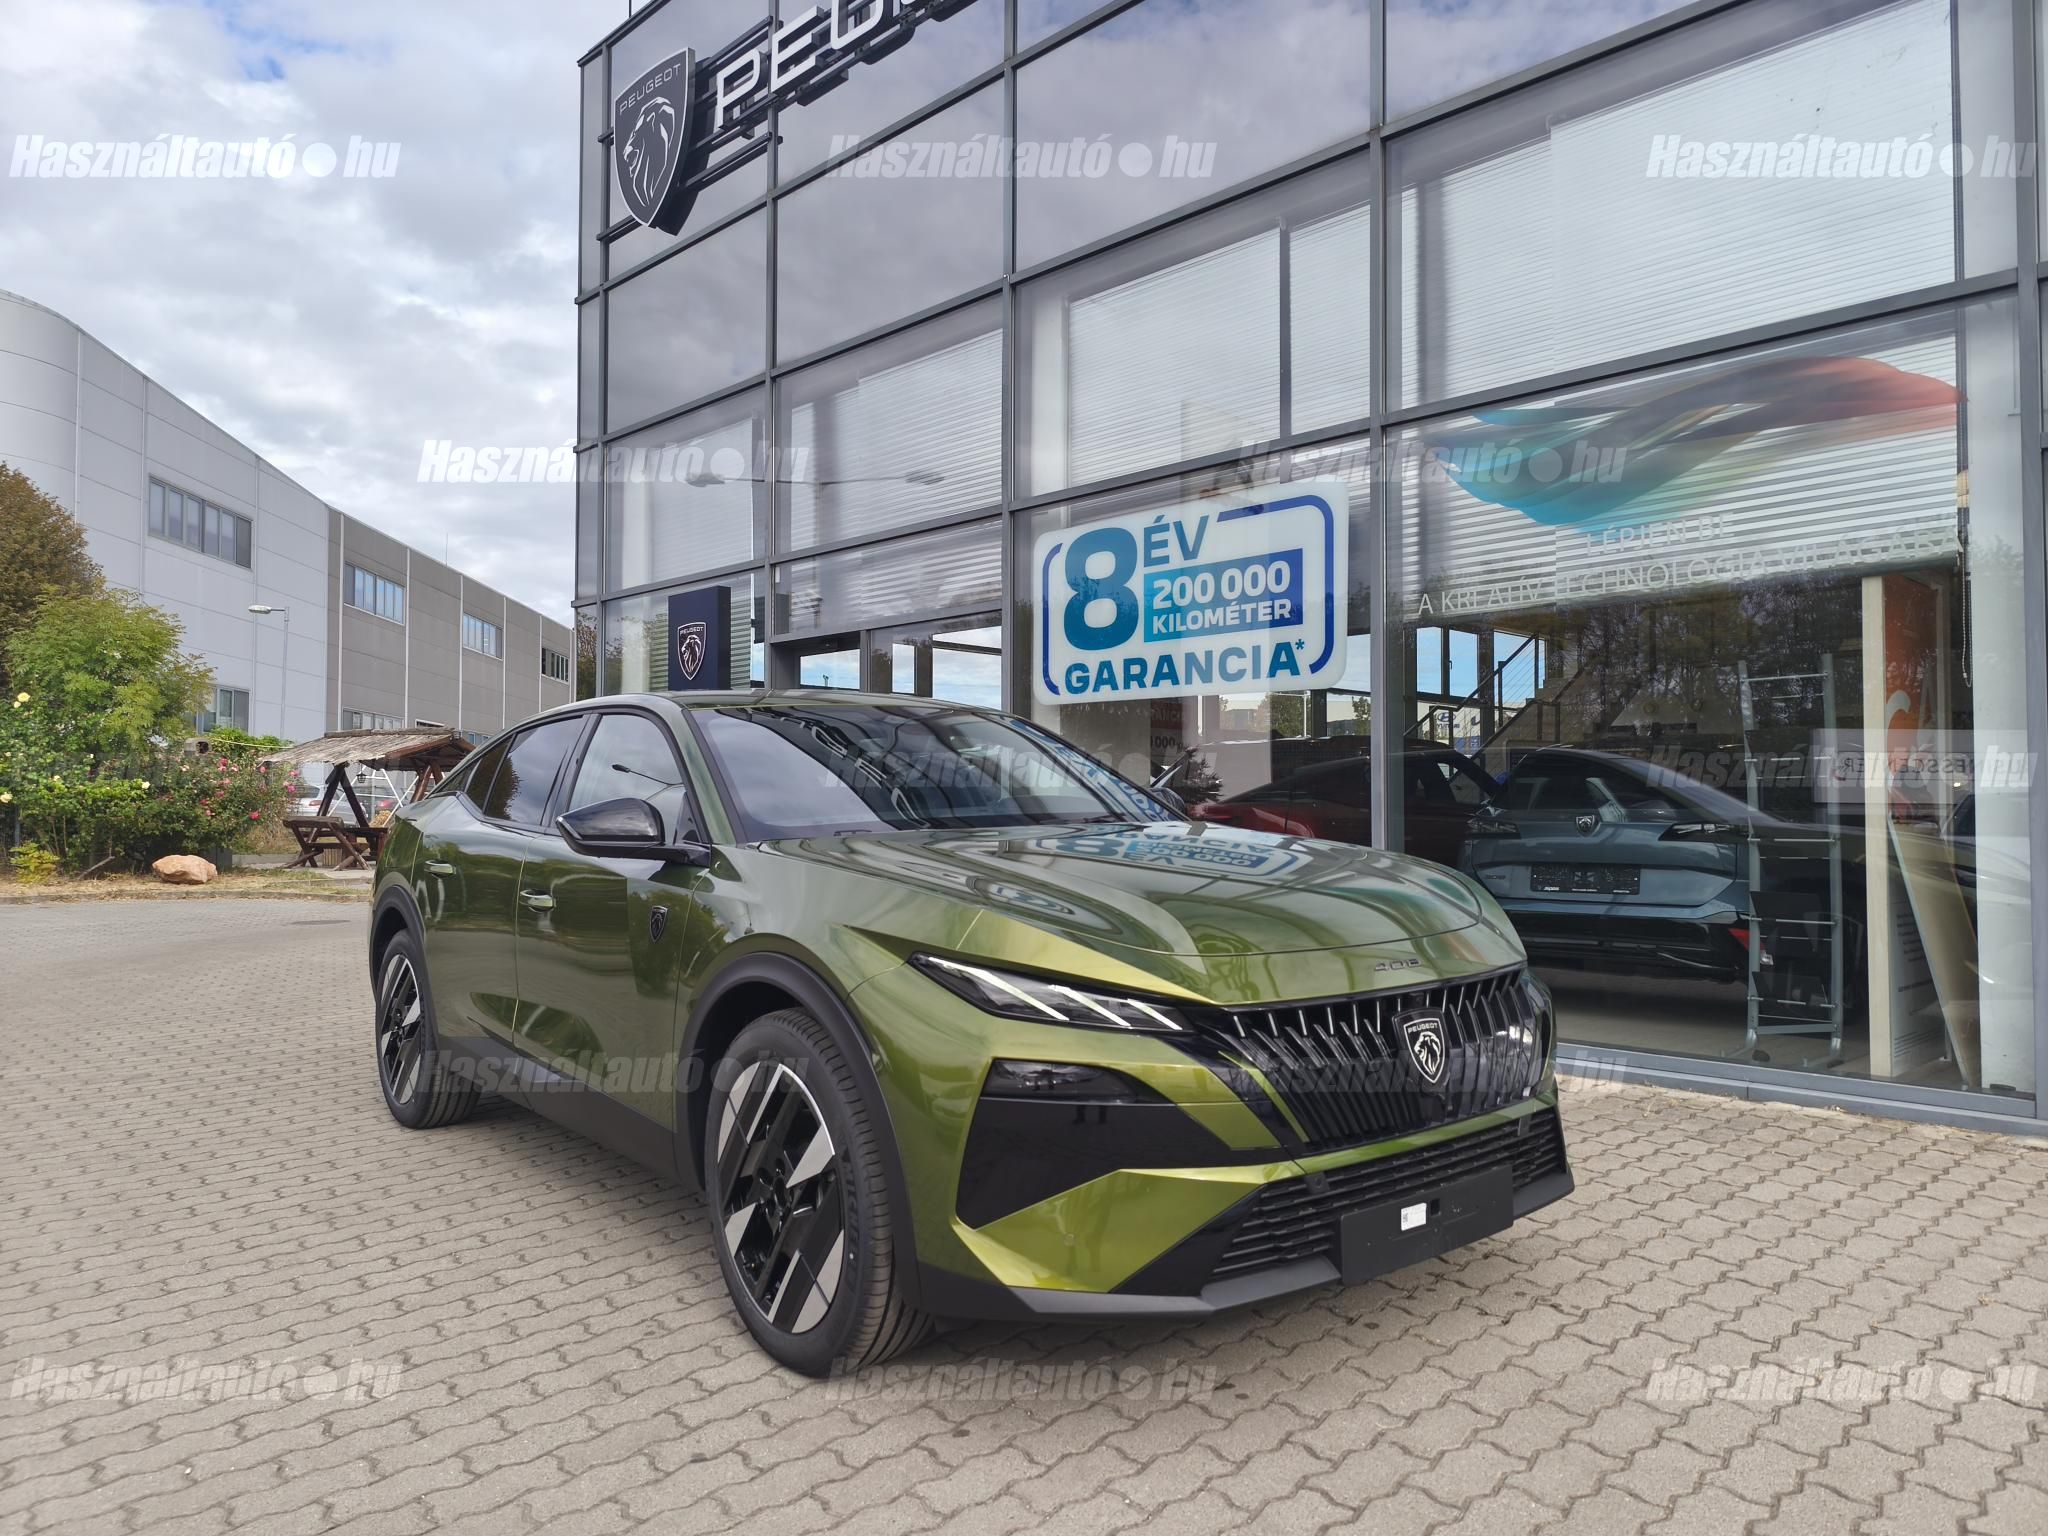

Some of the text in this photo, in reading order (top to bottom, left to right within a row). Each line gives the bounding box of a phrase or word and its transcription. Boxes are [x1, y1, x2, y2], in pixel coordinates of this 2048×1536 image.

[619, 63, 681, 115] PEUGEOT
[717, 0, 916, 129] PEU
[1144, 514, 1209, 567] ÉV
[1064, 527, 1138, 650] 8
[1153, 560, 1291, 609] 200 000
[1418, 593, 1434, 615] A
[1153, 598, 1291, 634] KILOMÉTER
[1407, 1022, 1438, 1034] PEUGEOT
